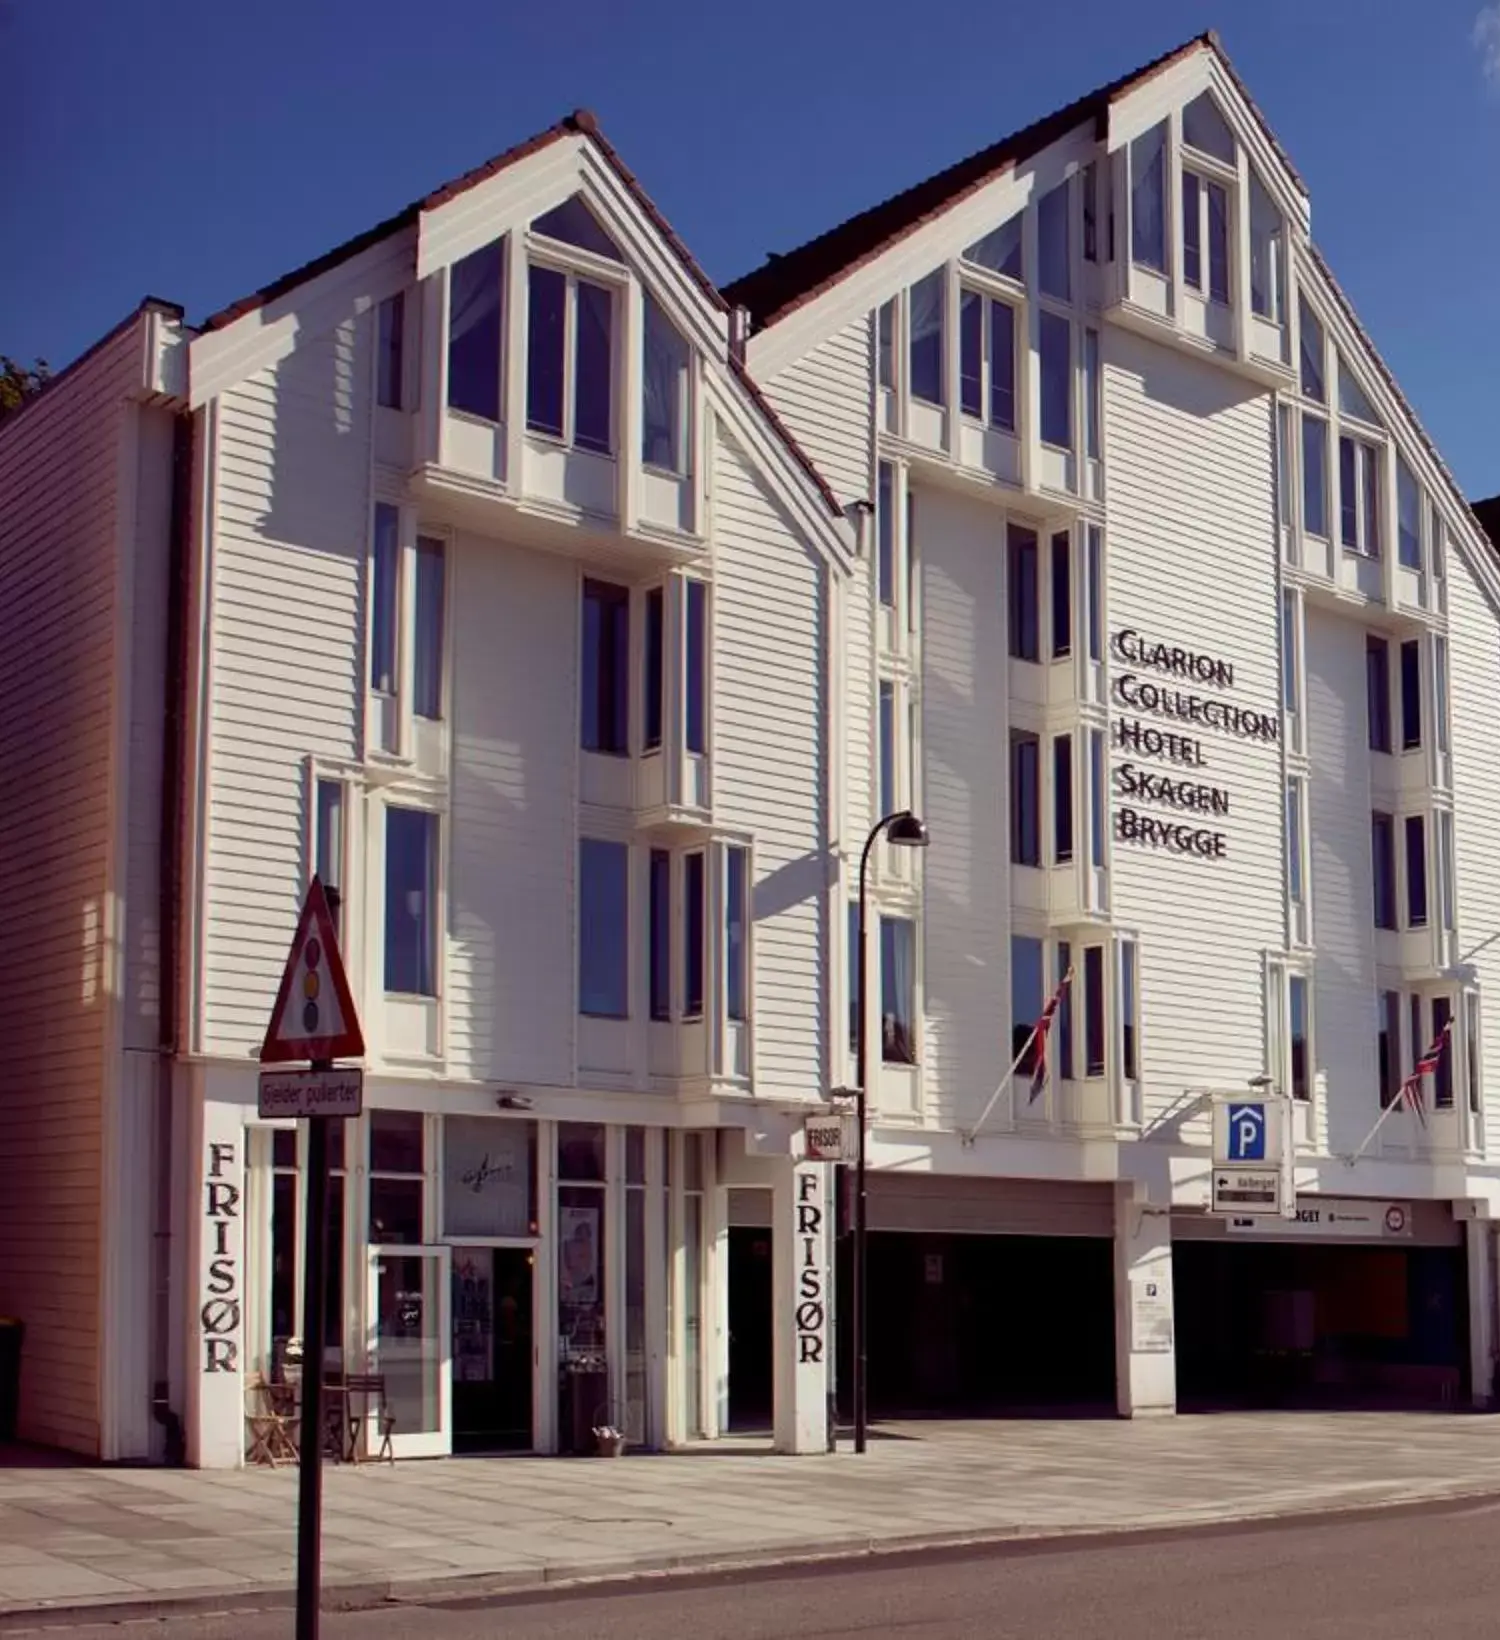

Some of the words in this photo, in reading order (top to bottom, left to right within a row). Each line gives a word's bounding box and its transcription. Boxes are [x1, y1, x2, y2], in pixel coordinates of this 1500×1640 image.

[1239, 1121, 1257, 1157] P
[201, 1142, 240, 1373] FRISØR
[795, 1173, 824, 1363] FRISØR
